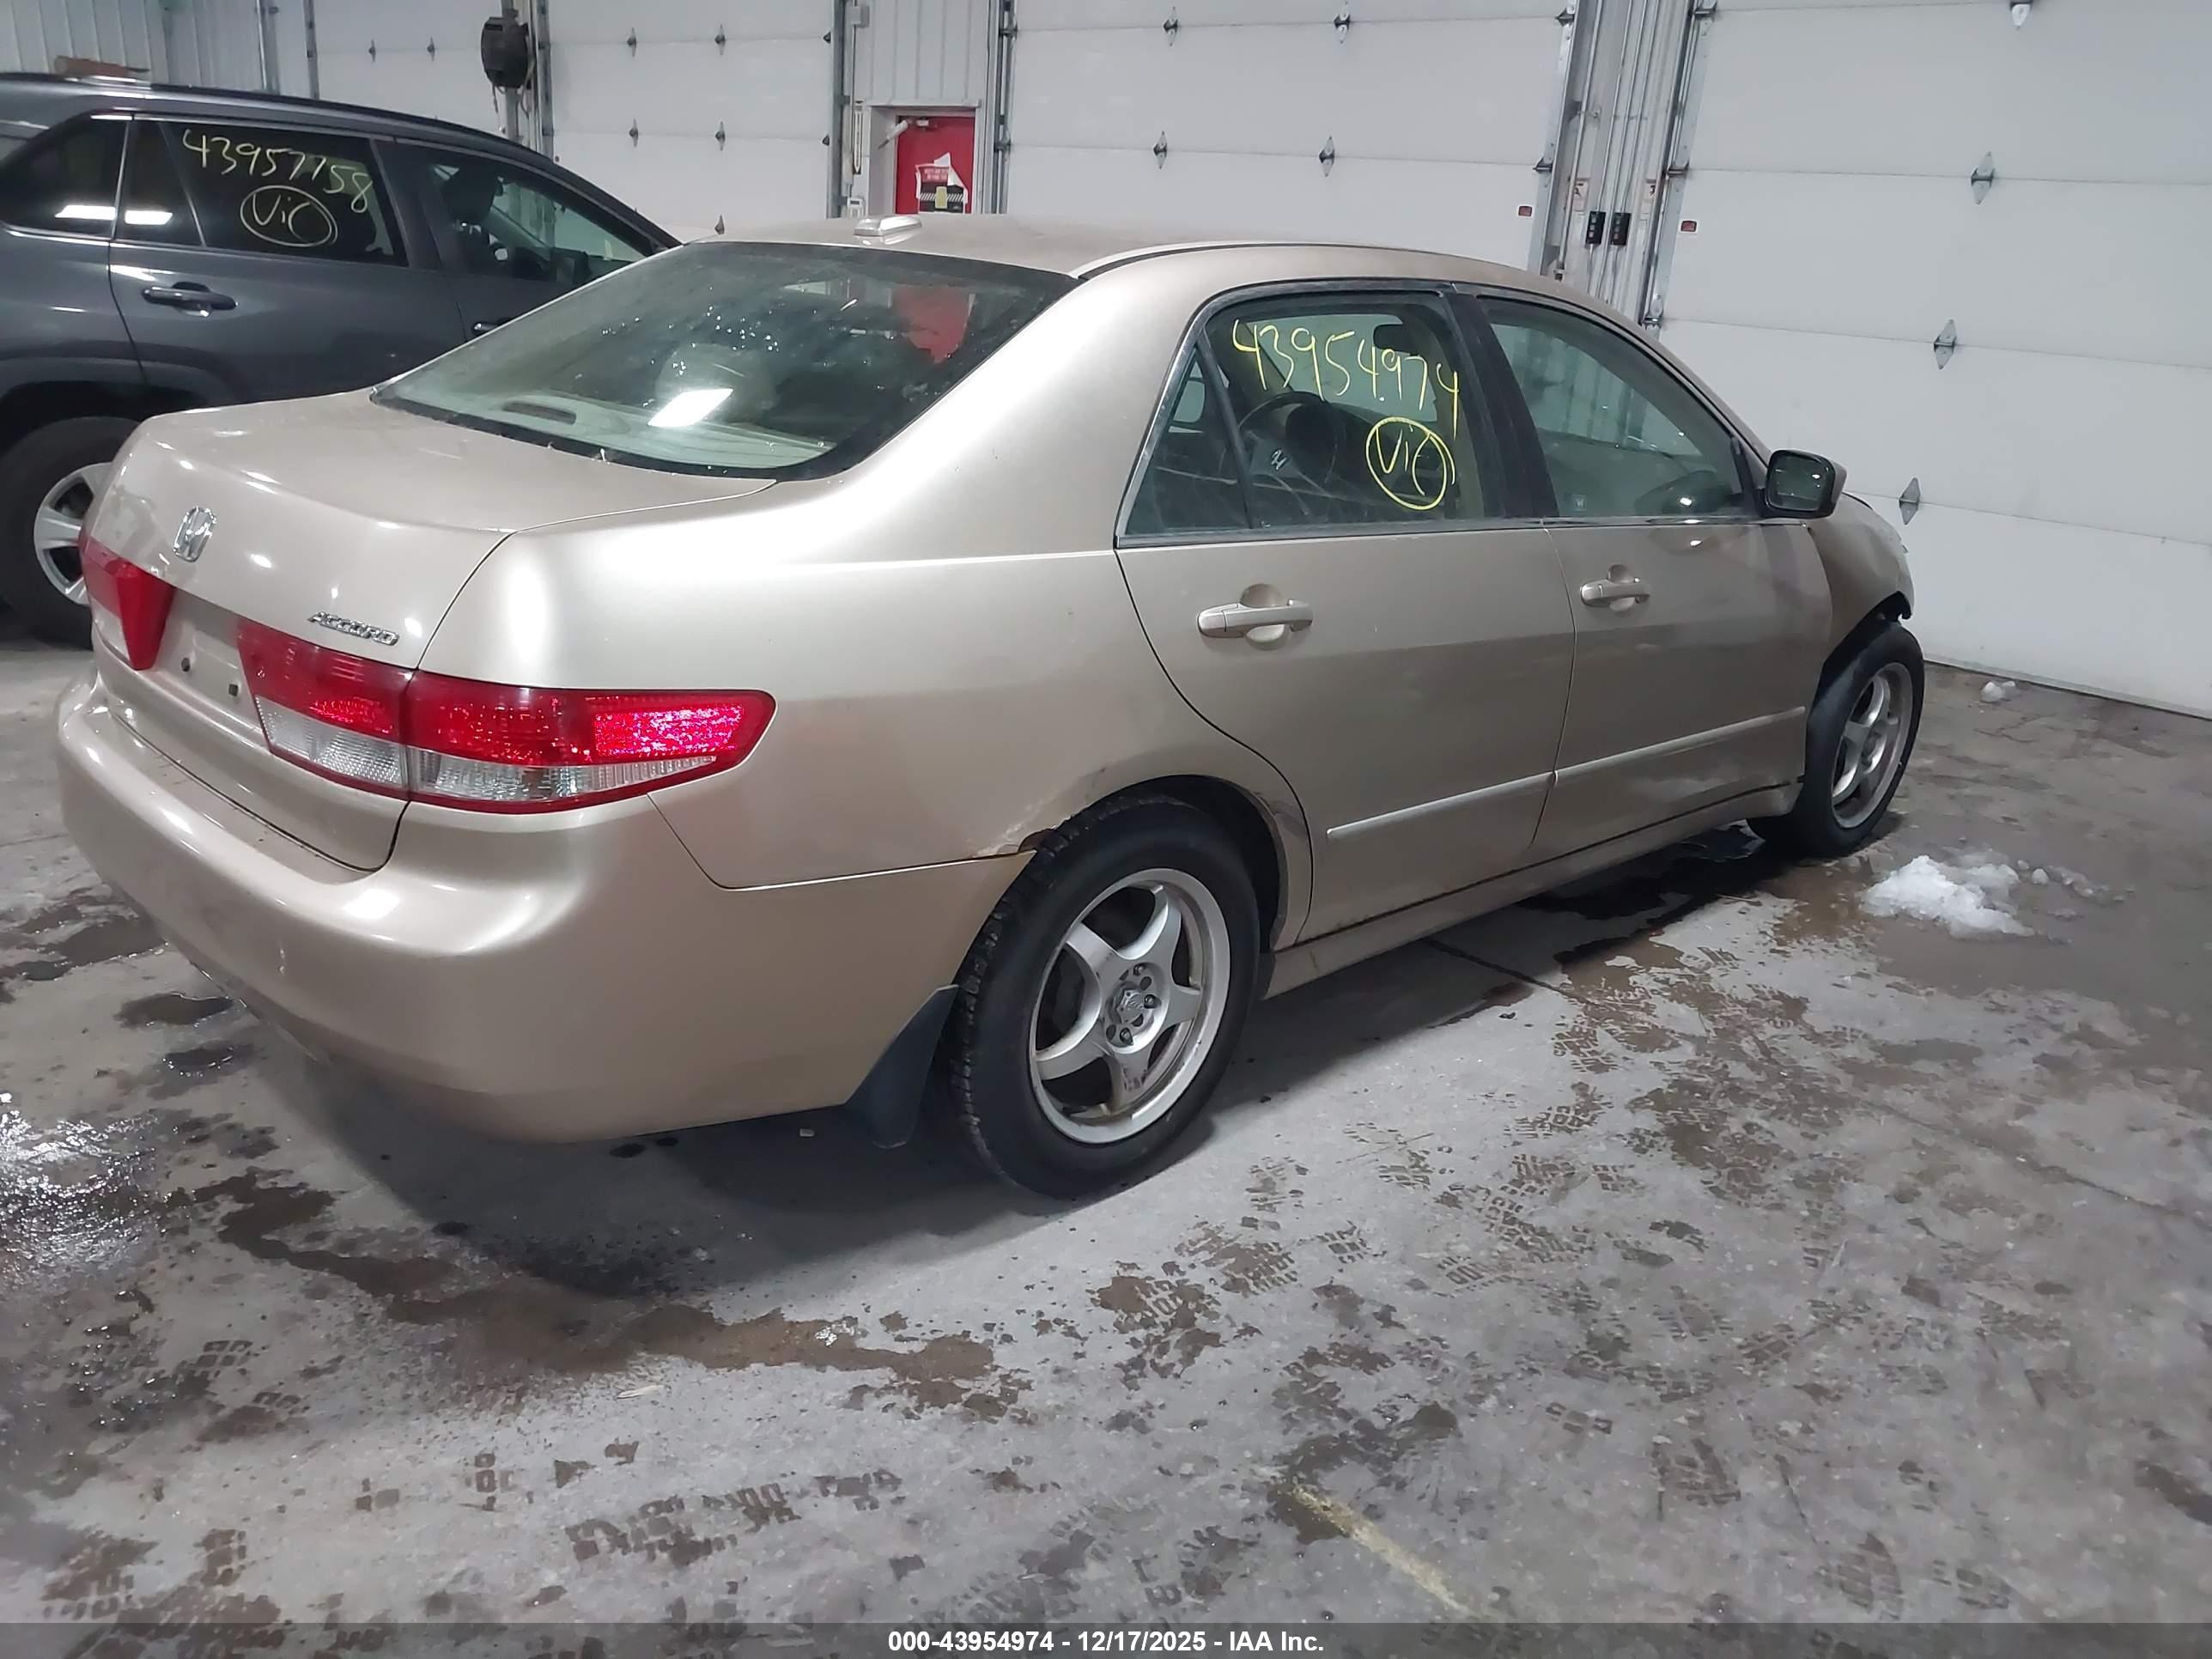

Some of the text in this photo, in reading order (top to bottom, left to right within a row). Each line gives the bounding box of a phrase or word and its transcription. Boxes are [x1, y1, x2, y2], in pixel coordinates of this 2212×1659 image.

[183, 129, 374, 214] 43957758
[1232, 319, 1460, 441] 43954974
[308, 611, 399, 646] ACCORD
